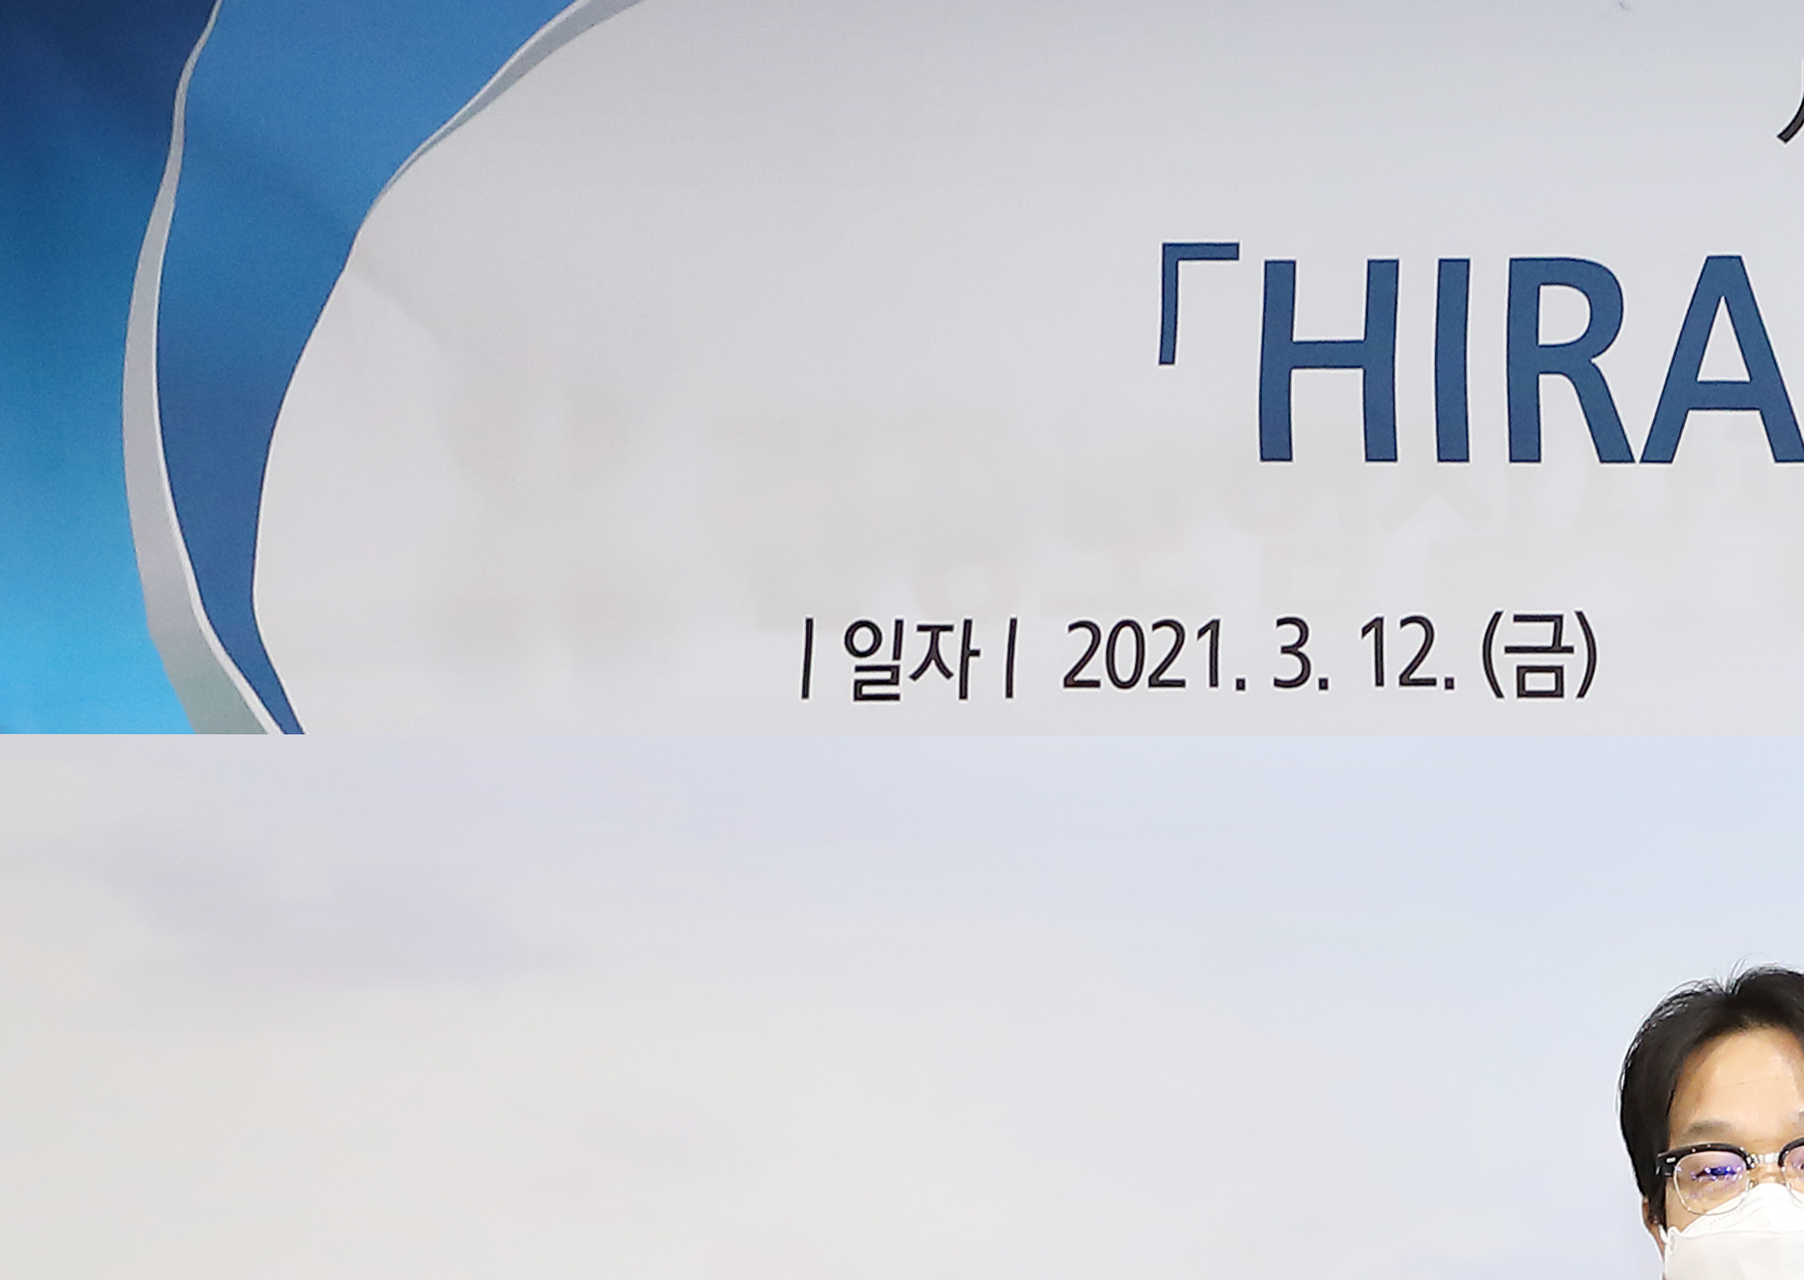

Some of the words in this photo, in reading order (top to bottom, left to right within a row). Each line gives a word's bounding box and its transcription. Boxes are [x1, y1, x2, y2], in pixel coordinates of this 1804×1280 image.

[1064, 619, 1246, 691] 2021.
[1274, 617, 1329, 691] 3.
[1362, 616, 1455, 690] 12.
[1483, 611, 1597, 698] (금)
